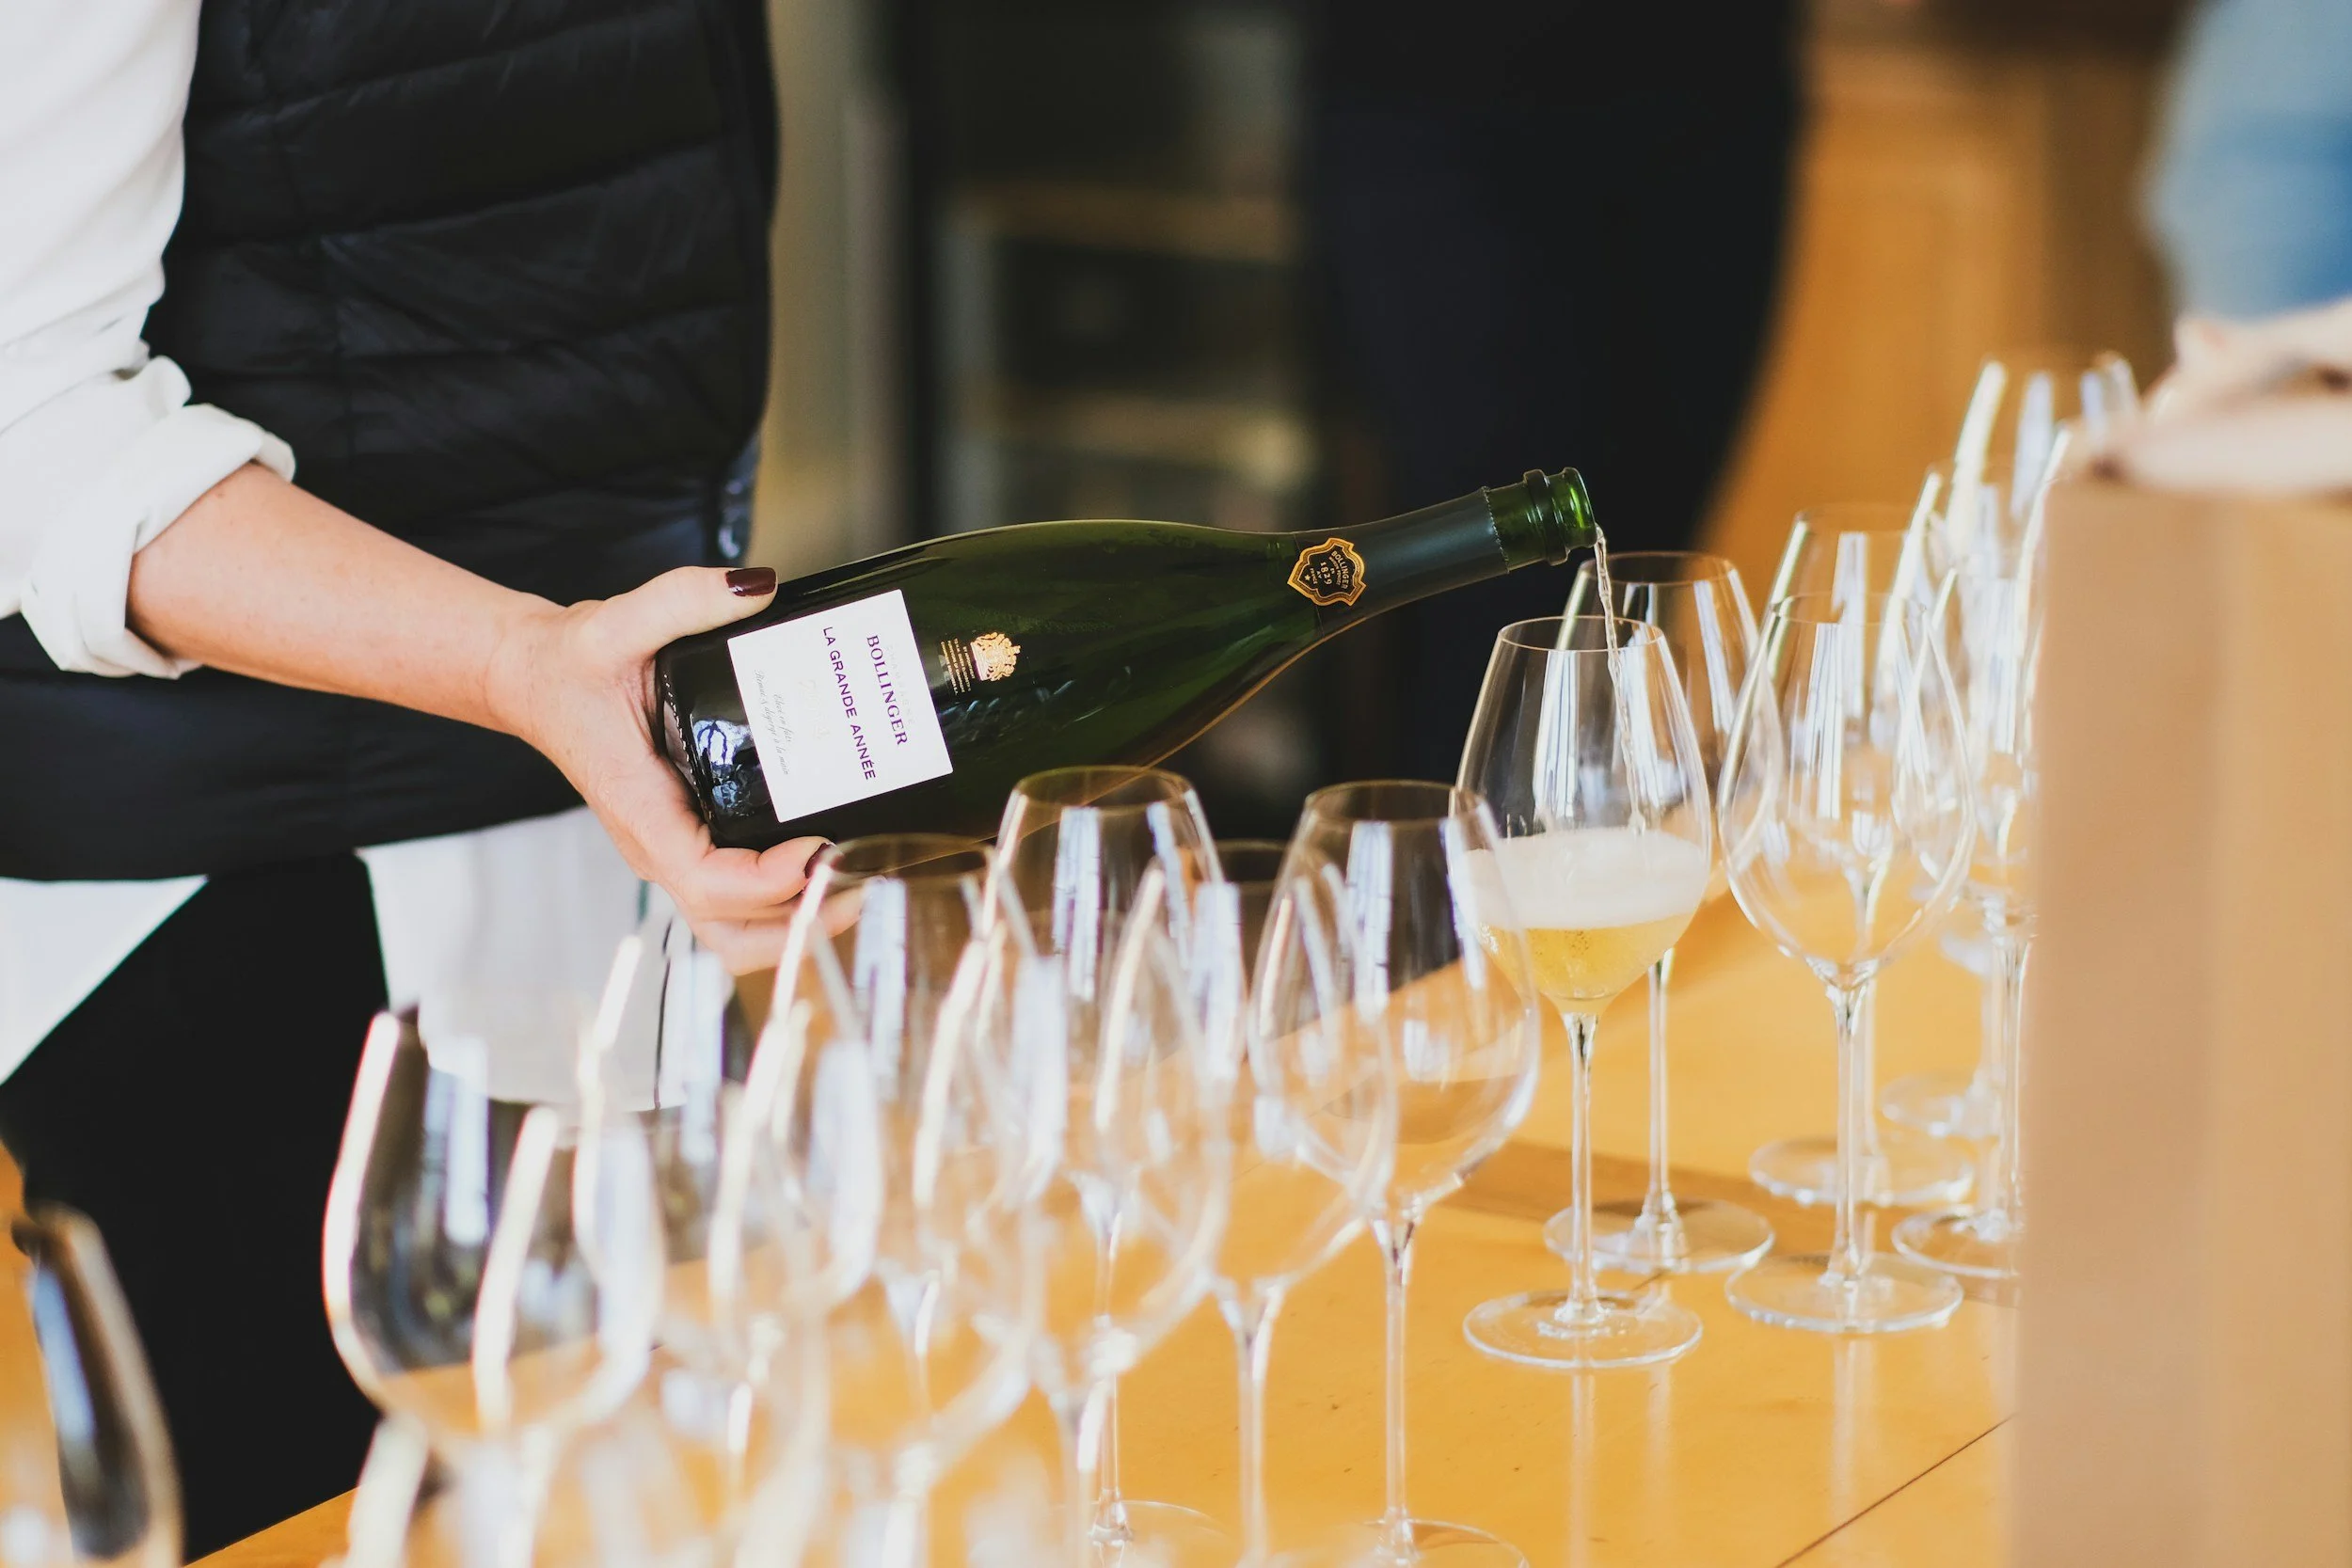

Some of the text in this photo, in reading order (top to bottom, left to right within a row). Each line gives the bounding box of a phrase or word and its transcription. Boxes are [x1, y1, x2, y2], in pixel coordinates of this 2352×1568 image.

[1320, 562, 1332, 584] 1829
[1331, 550, 1349, 589] BOLLINGER
[823, 626, 876, 780] LA GRANDE ANNÉE
[866, 635, 908, 745] BOLLINGER
